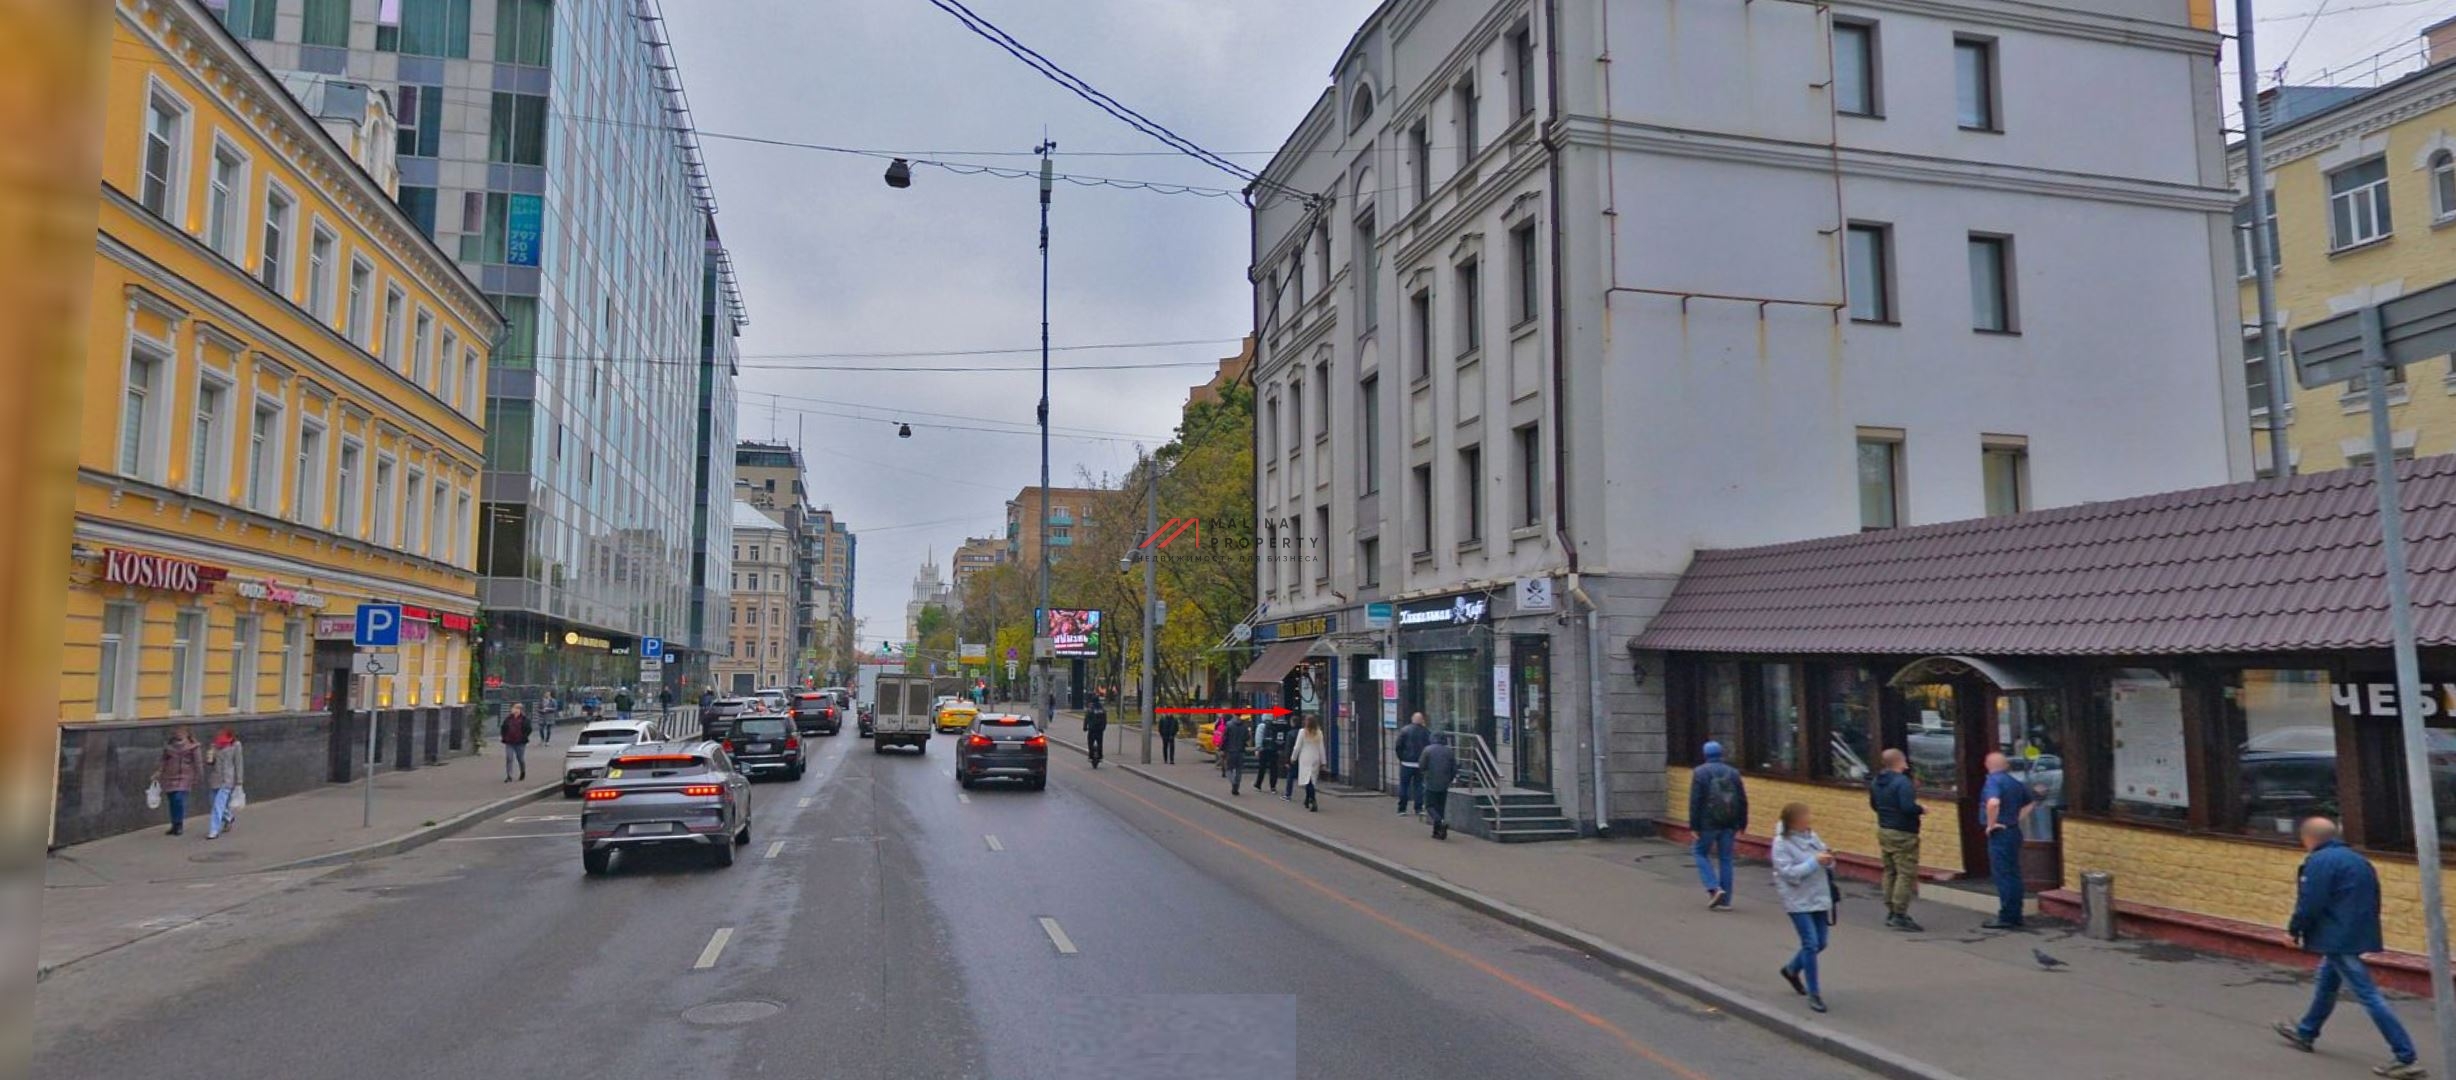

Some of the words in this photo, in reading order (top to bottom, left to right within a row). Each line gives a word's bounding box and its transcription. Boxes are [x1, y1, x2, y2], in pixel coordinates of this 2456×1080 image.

[510, 230, 537, 241] 797
[510, 241, 528, 252] 20
[509, 252, 528, 262] 75
[105, 550, 199, 592] KOSMOS
[366, 608, 393, 642] P
[647, 639, 659, 655] P
